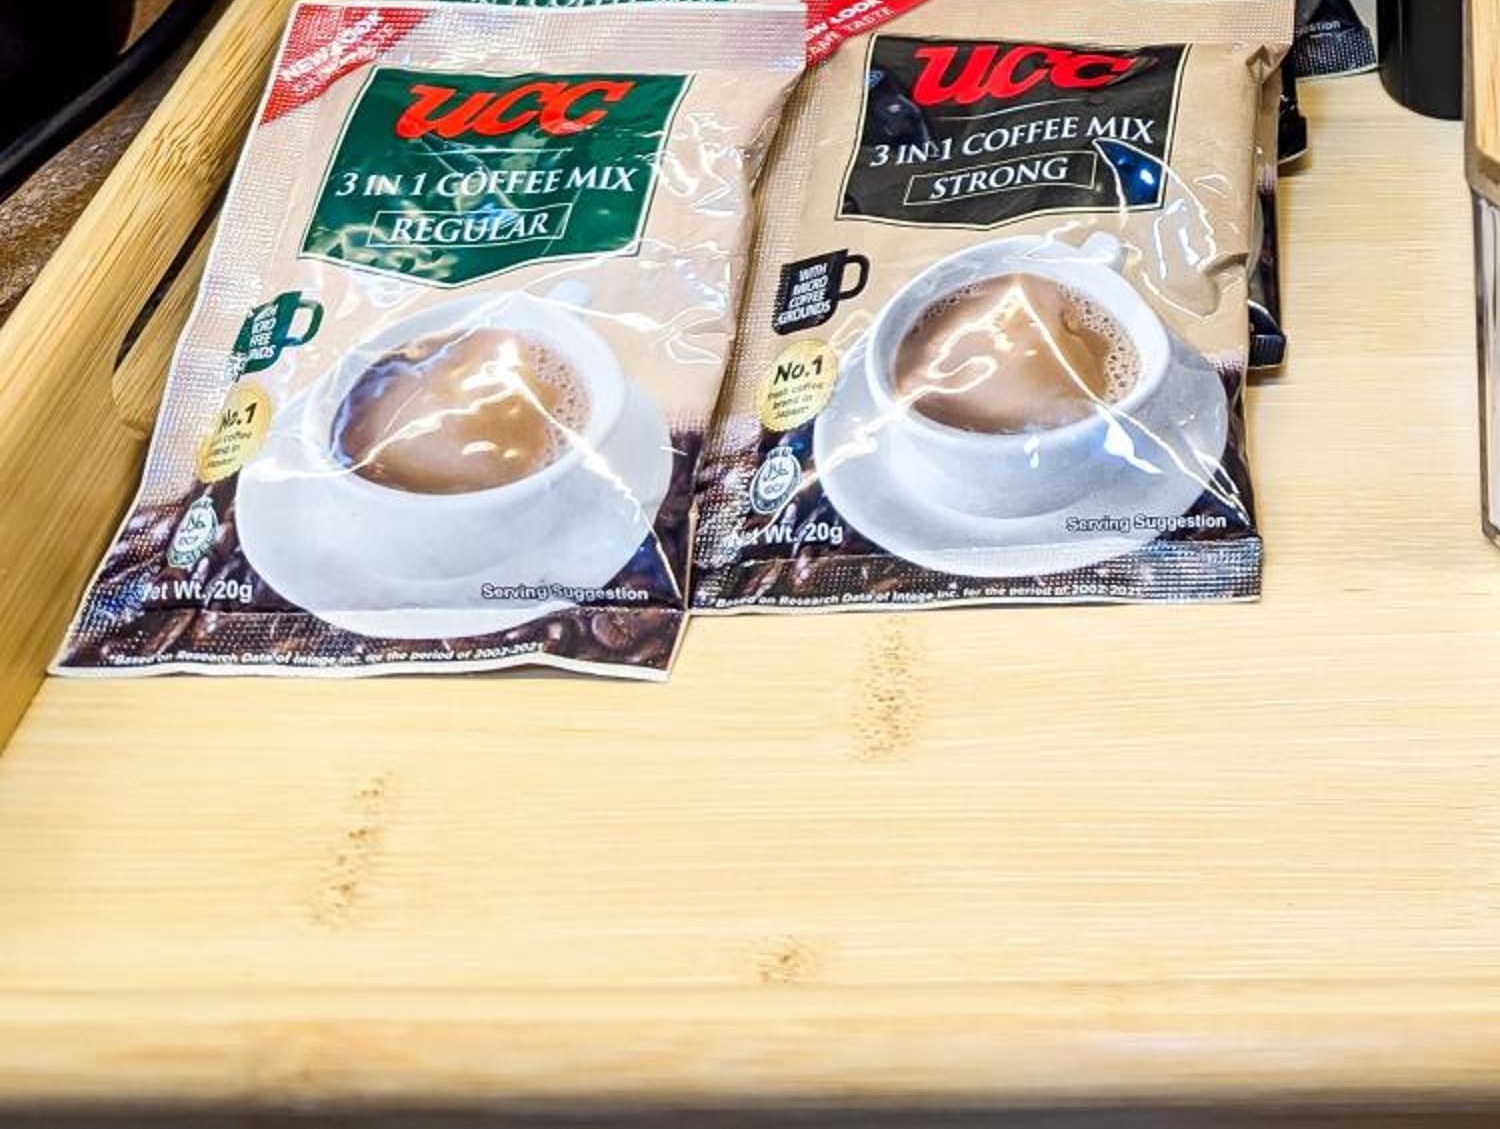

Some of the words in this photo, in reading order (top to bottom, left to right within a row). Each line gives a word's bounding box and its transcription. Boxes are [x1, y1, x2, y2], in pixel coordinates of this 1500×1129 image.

[843, 5, 897, 32] TASTE
[869, 144, 888, 168] 3
[895, 140, 929, 165] IN
[939, 137, 953, 161] 1
[961, 116, 1078, 157] COFFEE
[1086, 115, 1154, 144] MIX
[335, 172, 359, 196] 3
[363, 173, 403, 196] IN
[411, 172, 428, 196] 1
[436, 167, 564, 198] COFFEE
[564, 165, 640, 192] MIX
[929, 157, 1069, 200] STRONG
[388, 211, 549, 244] REGULAR
[788, 288, 828, 310] COFFEE
[777, 299, 832, 326] GROUNDS
[805, 521, 843, 545] 20g
[1065, 515, 1131, 533] Serving
[1133, 512, 1227, 532] Suggestion
[213, 579, 253, 604] 20g
[481, 582, 548, 601] Serving
[550, 583, 650, 601] Suggestion
[759, 595, 776, 606] on
[779, 594, 839, 606] Research
[842, 592, 872, 604] Data
[875, 590, 891, 602] of
[937, 589, 960, 600] Inc.
[963, 587, 982, 598] for
[984, 587, 1006, 597] the
[1009, 586, 1051, 597] period
[176, 650, 238, 664] Research
[241, 651, 272, 664] Data
[274, 651, 292, 665] of
[386, 650, 407, 662] the
[409, 648, 455, 662] period
